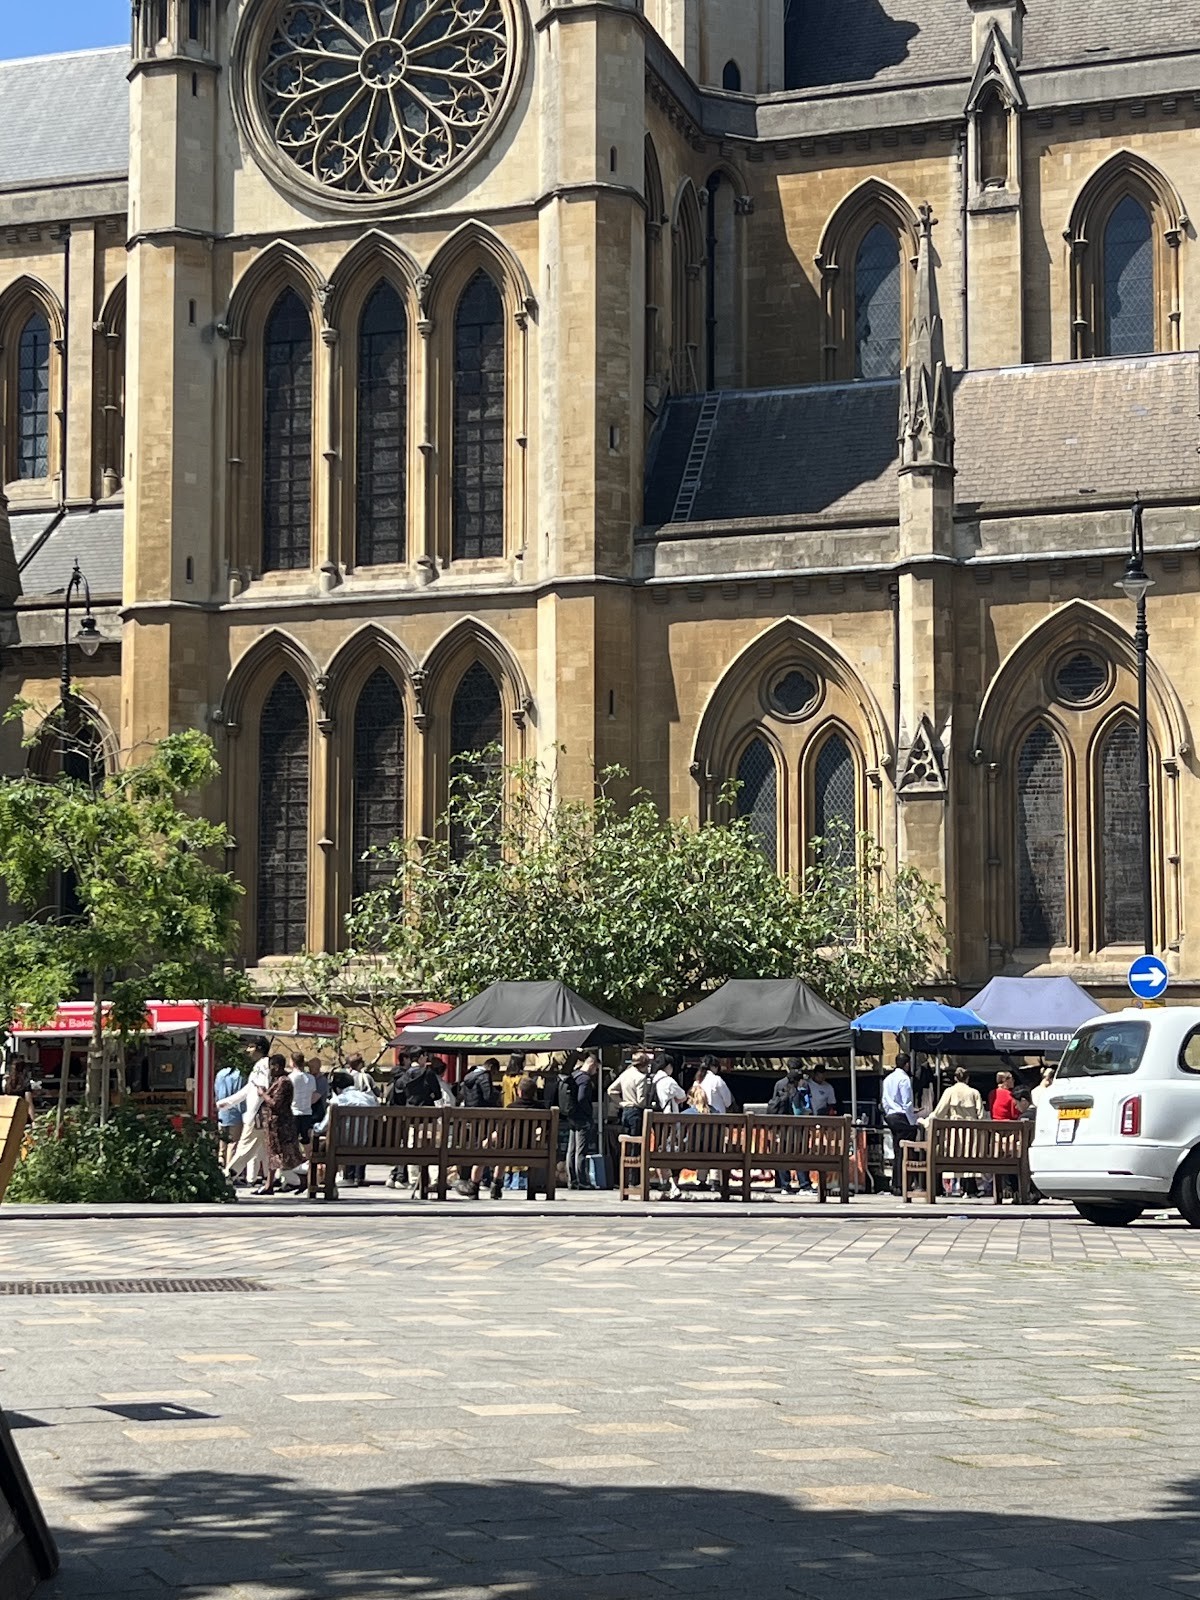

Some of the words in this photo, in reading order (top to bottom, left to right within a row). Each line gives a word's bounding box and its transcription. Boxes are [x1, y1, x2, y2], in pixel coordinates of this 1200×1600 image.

[68, 1018, 96, 1029] Bake
[434, 1033, 492, 1042] PURELY
[492, 1033, 552, 1042] FALAFEL
[963, 1030, 1012, 1041] Chicken
